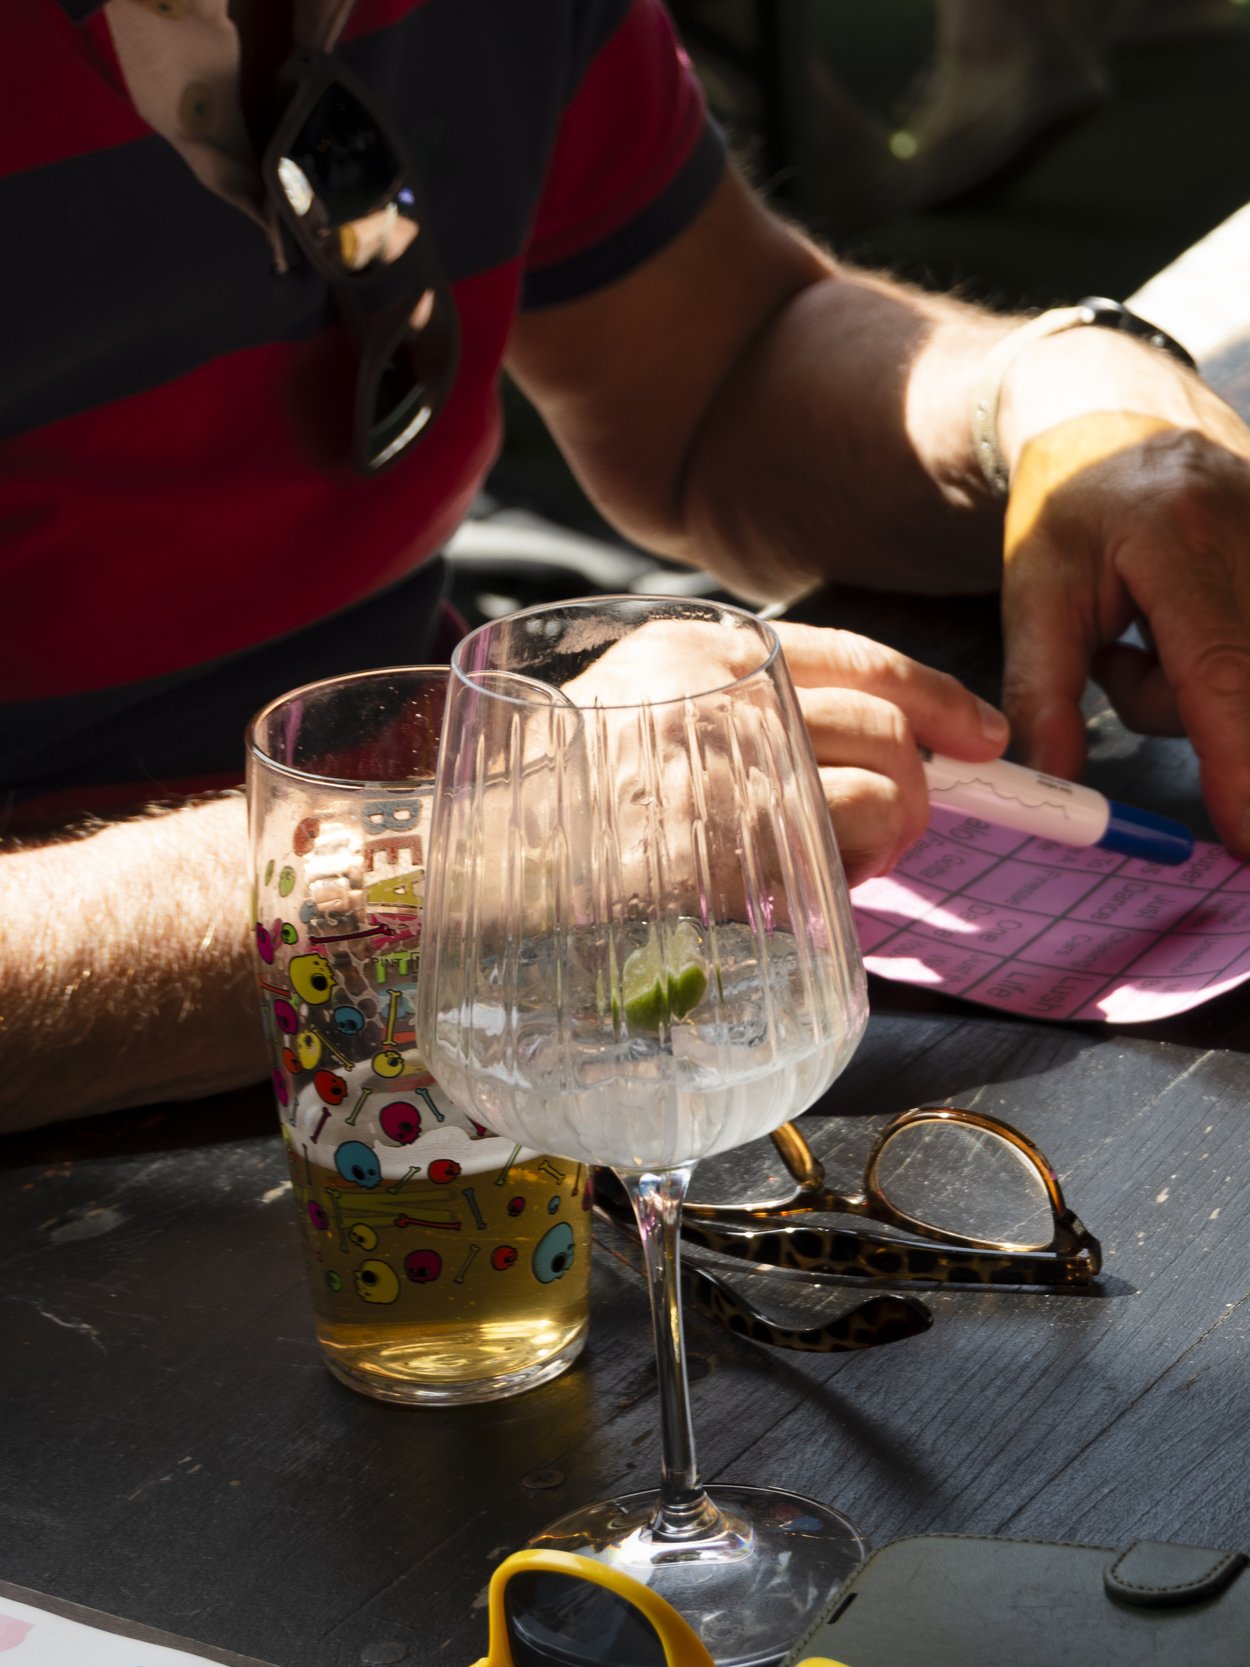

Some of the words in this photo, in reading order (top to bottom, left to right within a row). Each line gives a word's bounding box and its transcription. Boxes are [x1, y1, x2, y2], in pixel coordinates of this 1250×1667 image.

[949, 817, 991, 841] alo
[1090, 882, 1150, 921] Dance
[1133, 894, 1177, 920] Just
[977, 919, 1023, 943] One
[1055, 934, 1093, 957] Cars
[986, 971, 1041, 998] Life
[1030, 975, 1094, 1014] Lush
